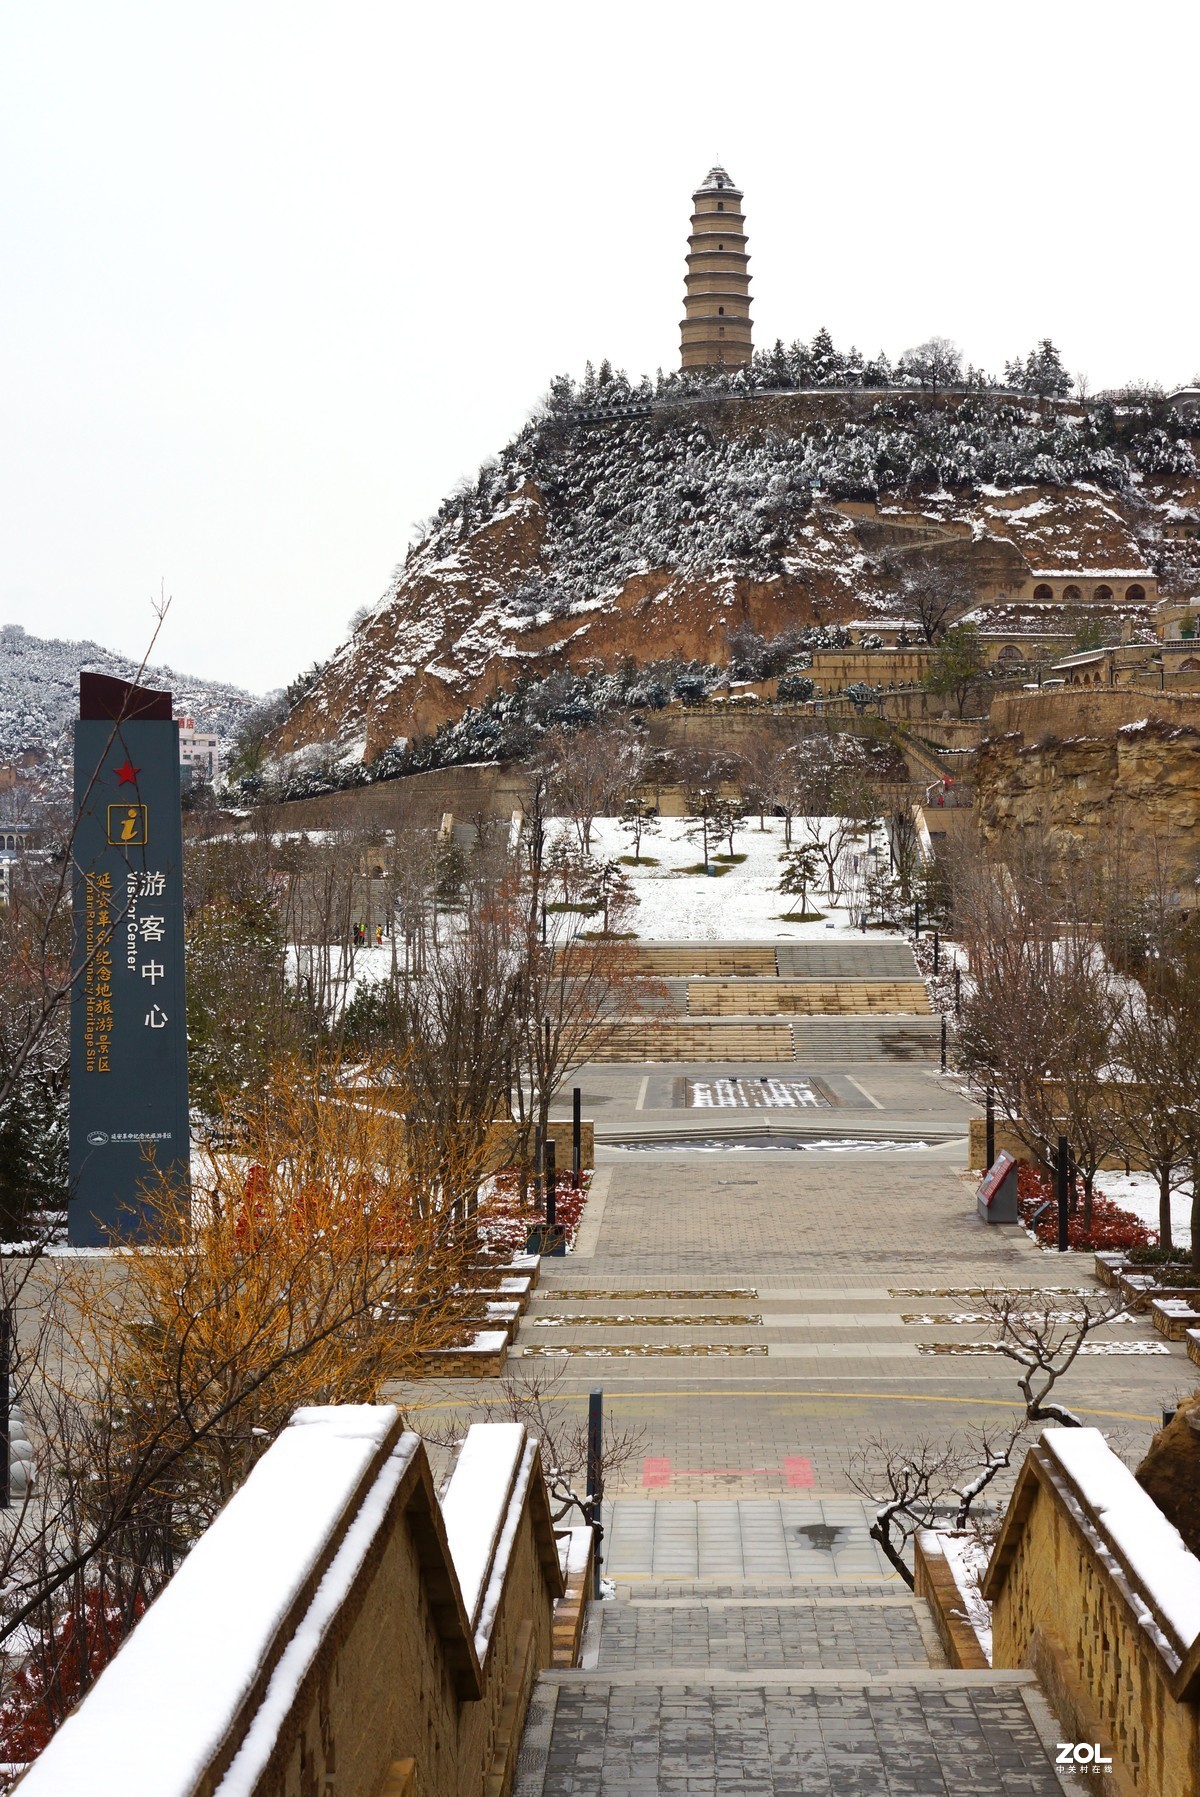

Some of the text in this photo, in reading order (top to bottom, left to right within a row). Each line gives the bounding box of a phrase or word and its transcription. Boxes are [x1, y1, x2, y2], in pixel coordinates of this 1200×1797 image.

[84, 911, 96, 994] Revolutonary
[127, 871, 138, 972] Visitor Center
[138, 870, 168, 1030] 游客中心
[95, 871, 114, 1072] 延安革命纪念地旅游景区
[84, 997, 96, 1047] Heritage
[86, 1049, 96, 1072] Site
